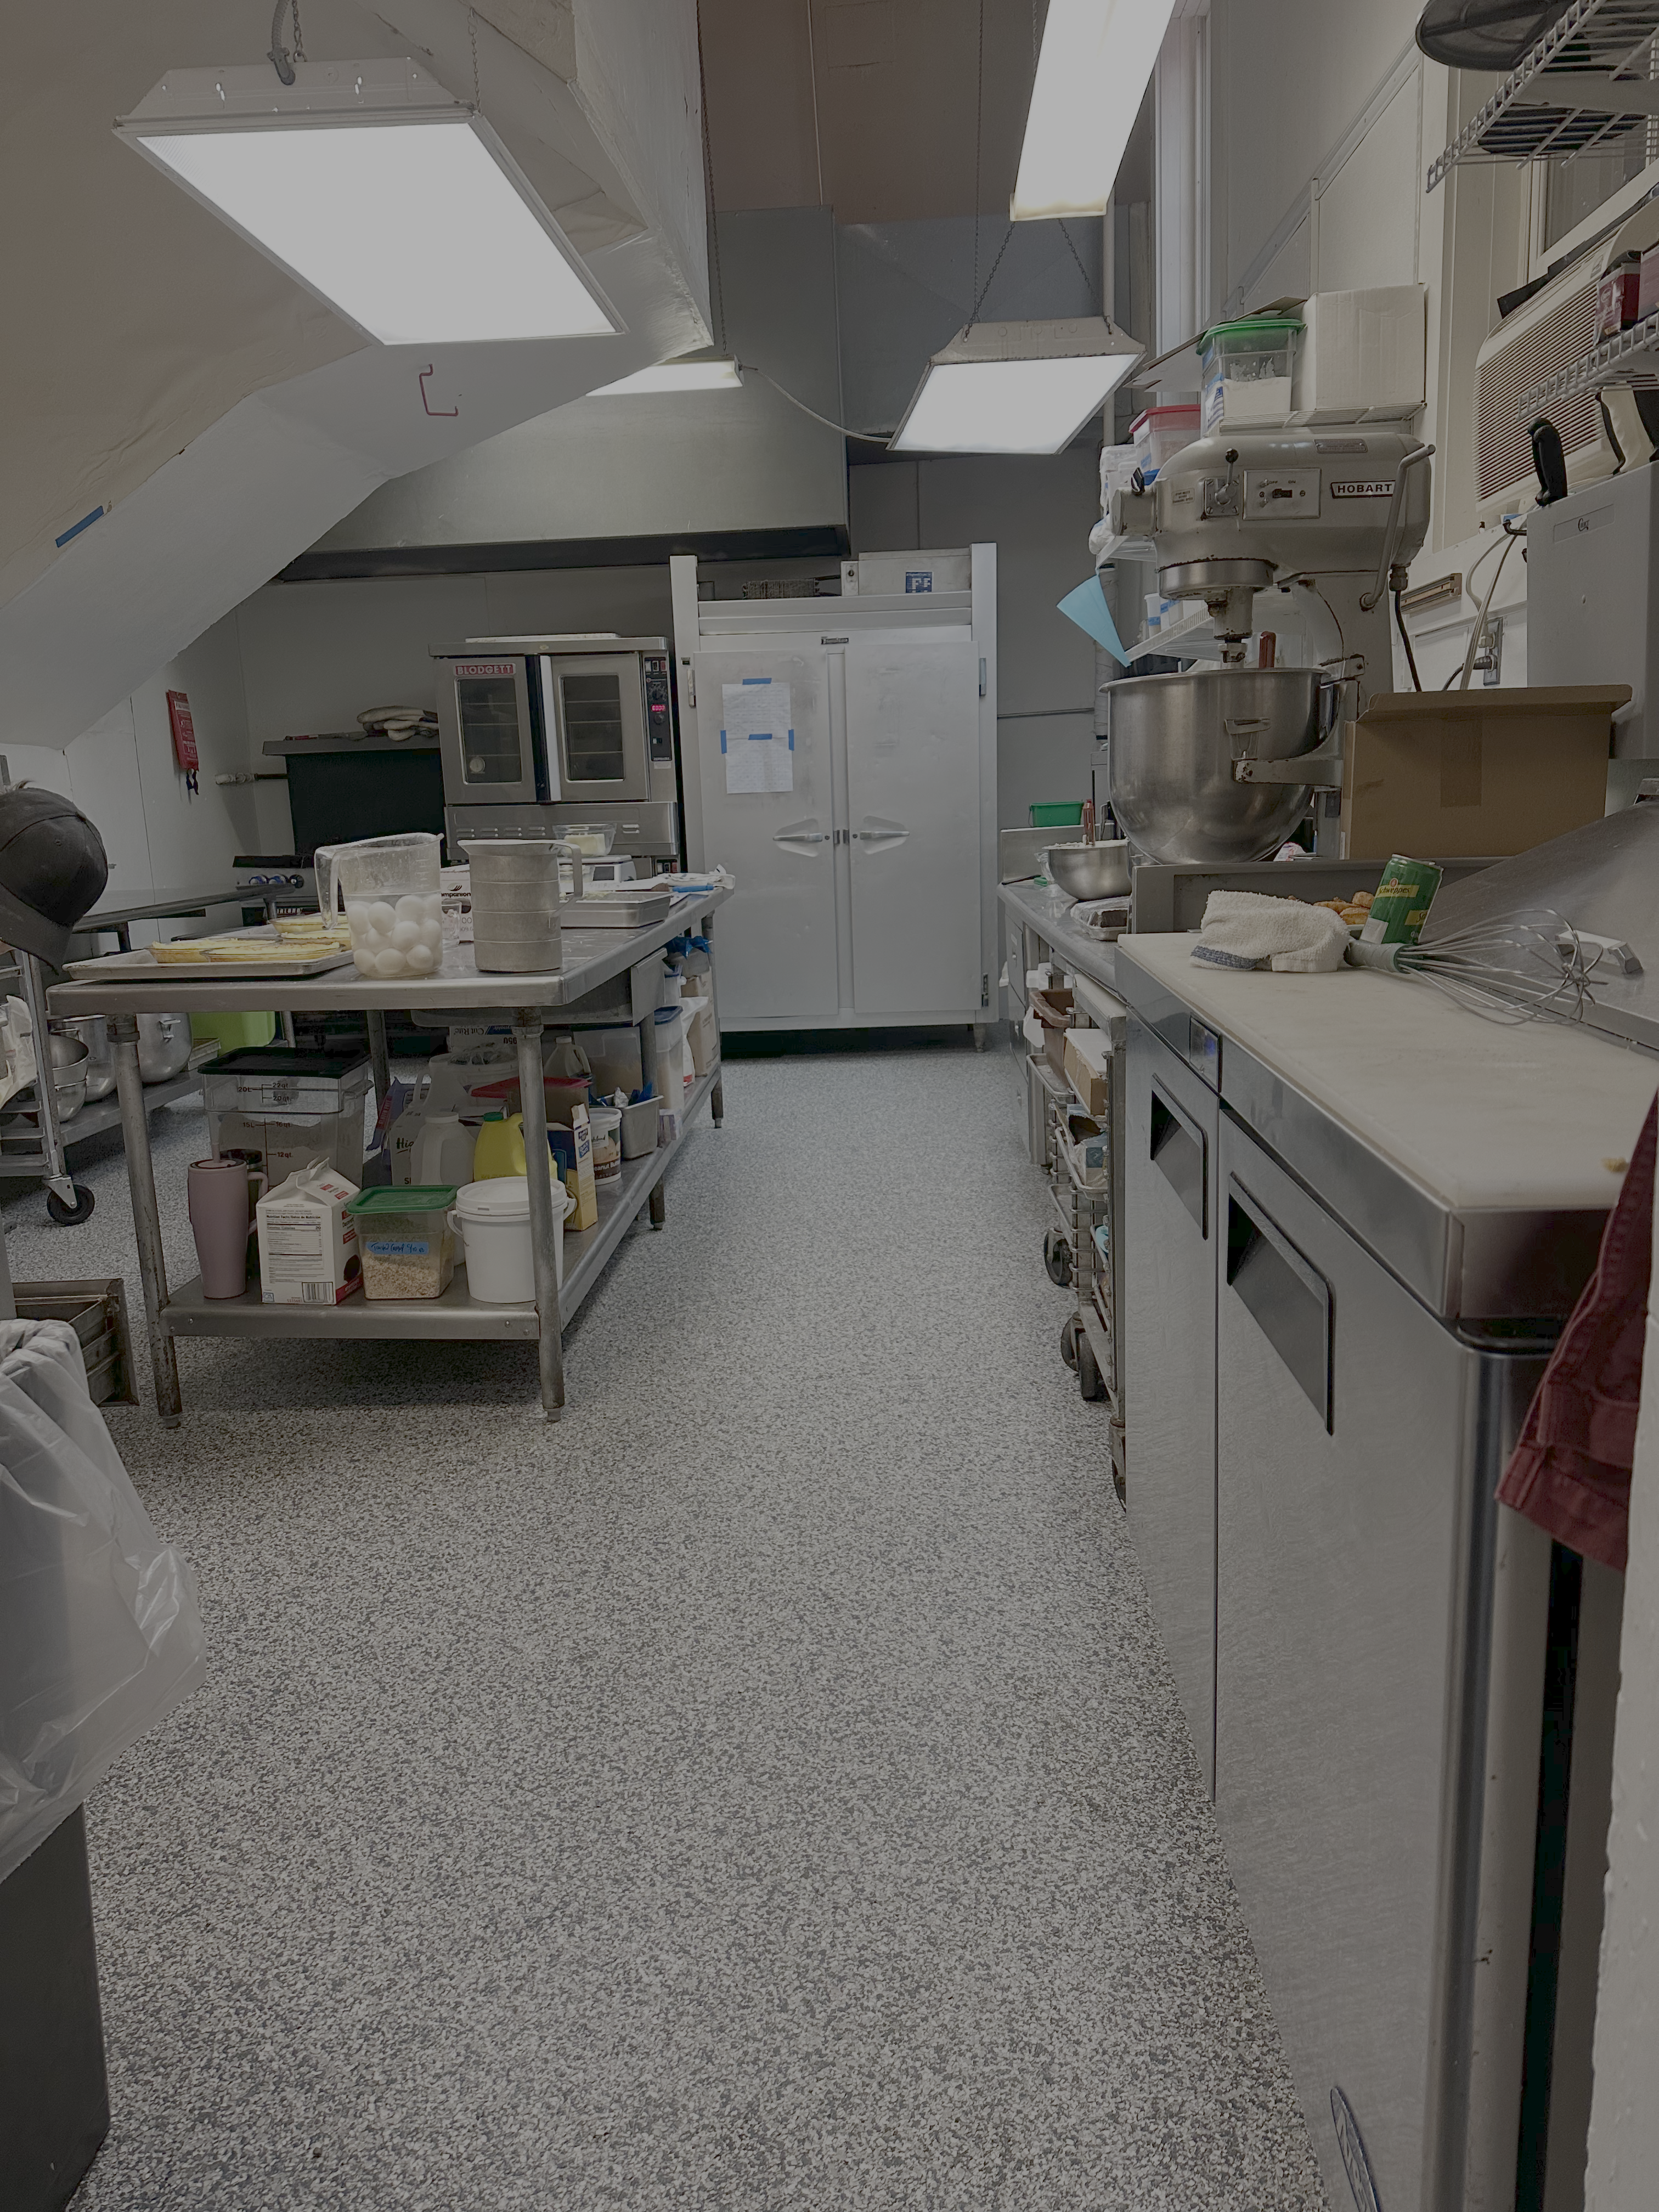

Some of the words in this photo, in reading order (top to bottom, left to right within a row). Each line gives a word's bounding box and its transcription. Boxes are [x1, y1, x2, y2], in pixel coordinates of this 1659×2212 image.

[1338, 483, 1392, 493] HOBART
[457, 665, 511, 675] BLODGETT
[594, 1163, 610, 1171] eanut
